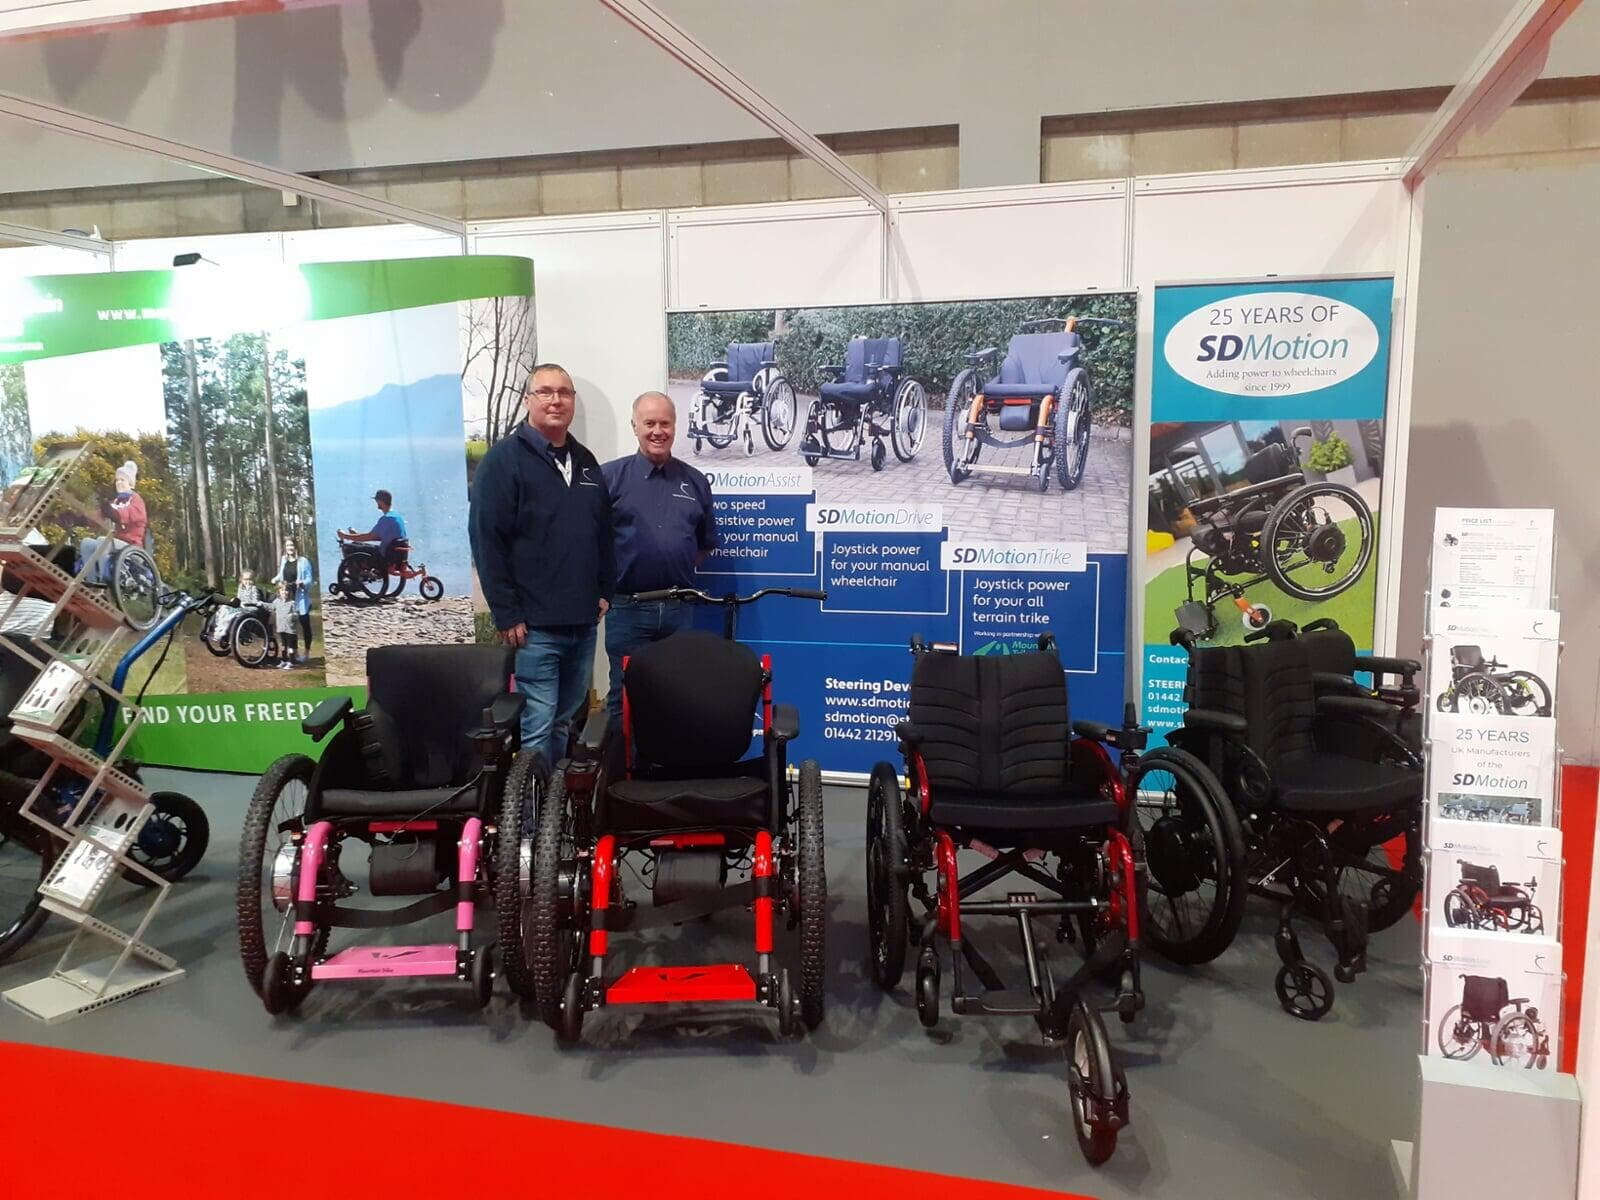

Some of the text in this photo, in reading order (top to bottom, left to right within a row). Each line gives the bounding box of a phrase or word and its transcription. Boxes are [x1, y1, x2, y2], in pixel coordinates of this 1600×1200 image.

[1210, 305, 1340, 326] 25 YEARS OF
[1197, 333, 1349, 361] SDMotion
[1206, 367, 1337, 380] Adding power to wheelchairs
[1245, 383, 1291, 391] since 1999
[704, 472, 802, 488] DMotionAssist
[713, 499, 765, 512] wo speed
[714, 515, 795, 529] sistive power
[817, 508, 933, 525] SDMotionDrive
[724, 533, 750, 544] your
[753, 531, 799, 542] manual
[831, 543, 921, 557] Joystick power
[953, 548, 1072, 565] SDMotionTrike
[831, 559, 929, 573] for your manual
[831, 576, 897, 587] wheelchair
[973, 578, 1070, 592] Joystick power
[973, 594, 1044, 609] for your all
[973, 612, 1050, 624] terrain trike
[1012, 641, 1038, 650] Moun
[825, 677, 911, 694] Steering Dev
[1148, 692, 1180, 702] 01442
[122, 701, 322, 724] FND YOUR FREED
[824, 727, 902, 742] 01442 21291
[1456, 728, 1530, 743] 25 YEARS
[1467, 747, 1531, 757] Manufacturers
[1488, 761, 1502, 769] the
[1452, 773, 1528, 790] SDMotion
